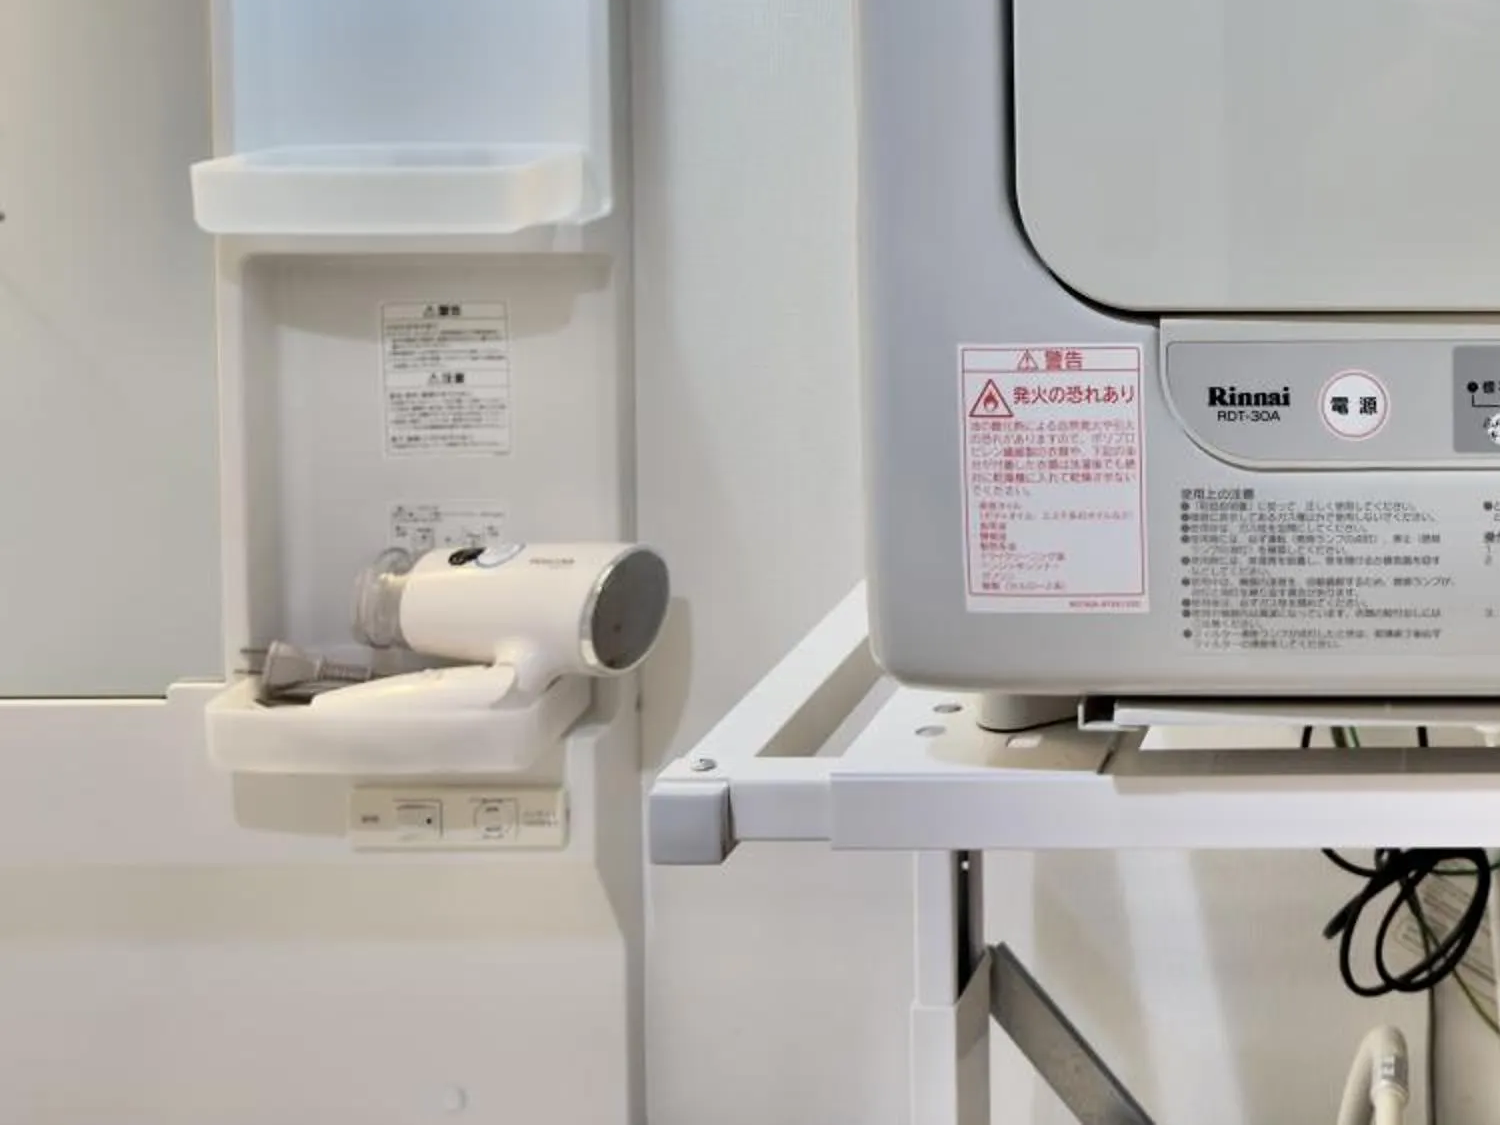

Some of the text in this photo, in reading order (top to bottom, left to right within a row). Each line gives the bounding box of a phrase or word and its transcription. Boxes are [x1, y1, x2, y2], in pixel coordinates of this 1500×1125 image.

[1013, 385, 1136, 404] 発火の恐れあり
[1207, 386, 1291, 407] Rinnai
[1330, 396, 1378, 416] 電源
[1217, 410, 1281, 422] RDT-30A
